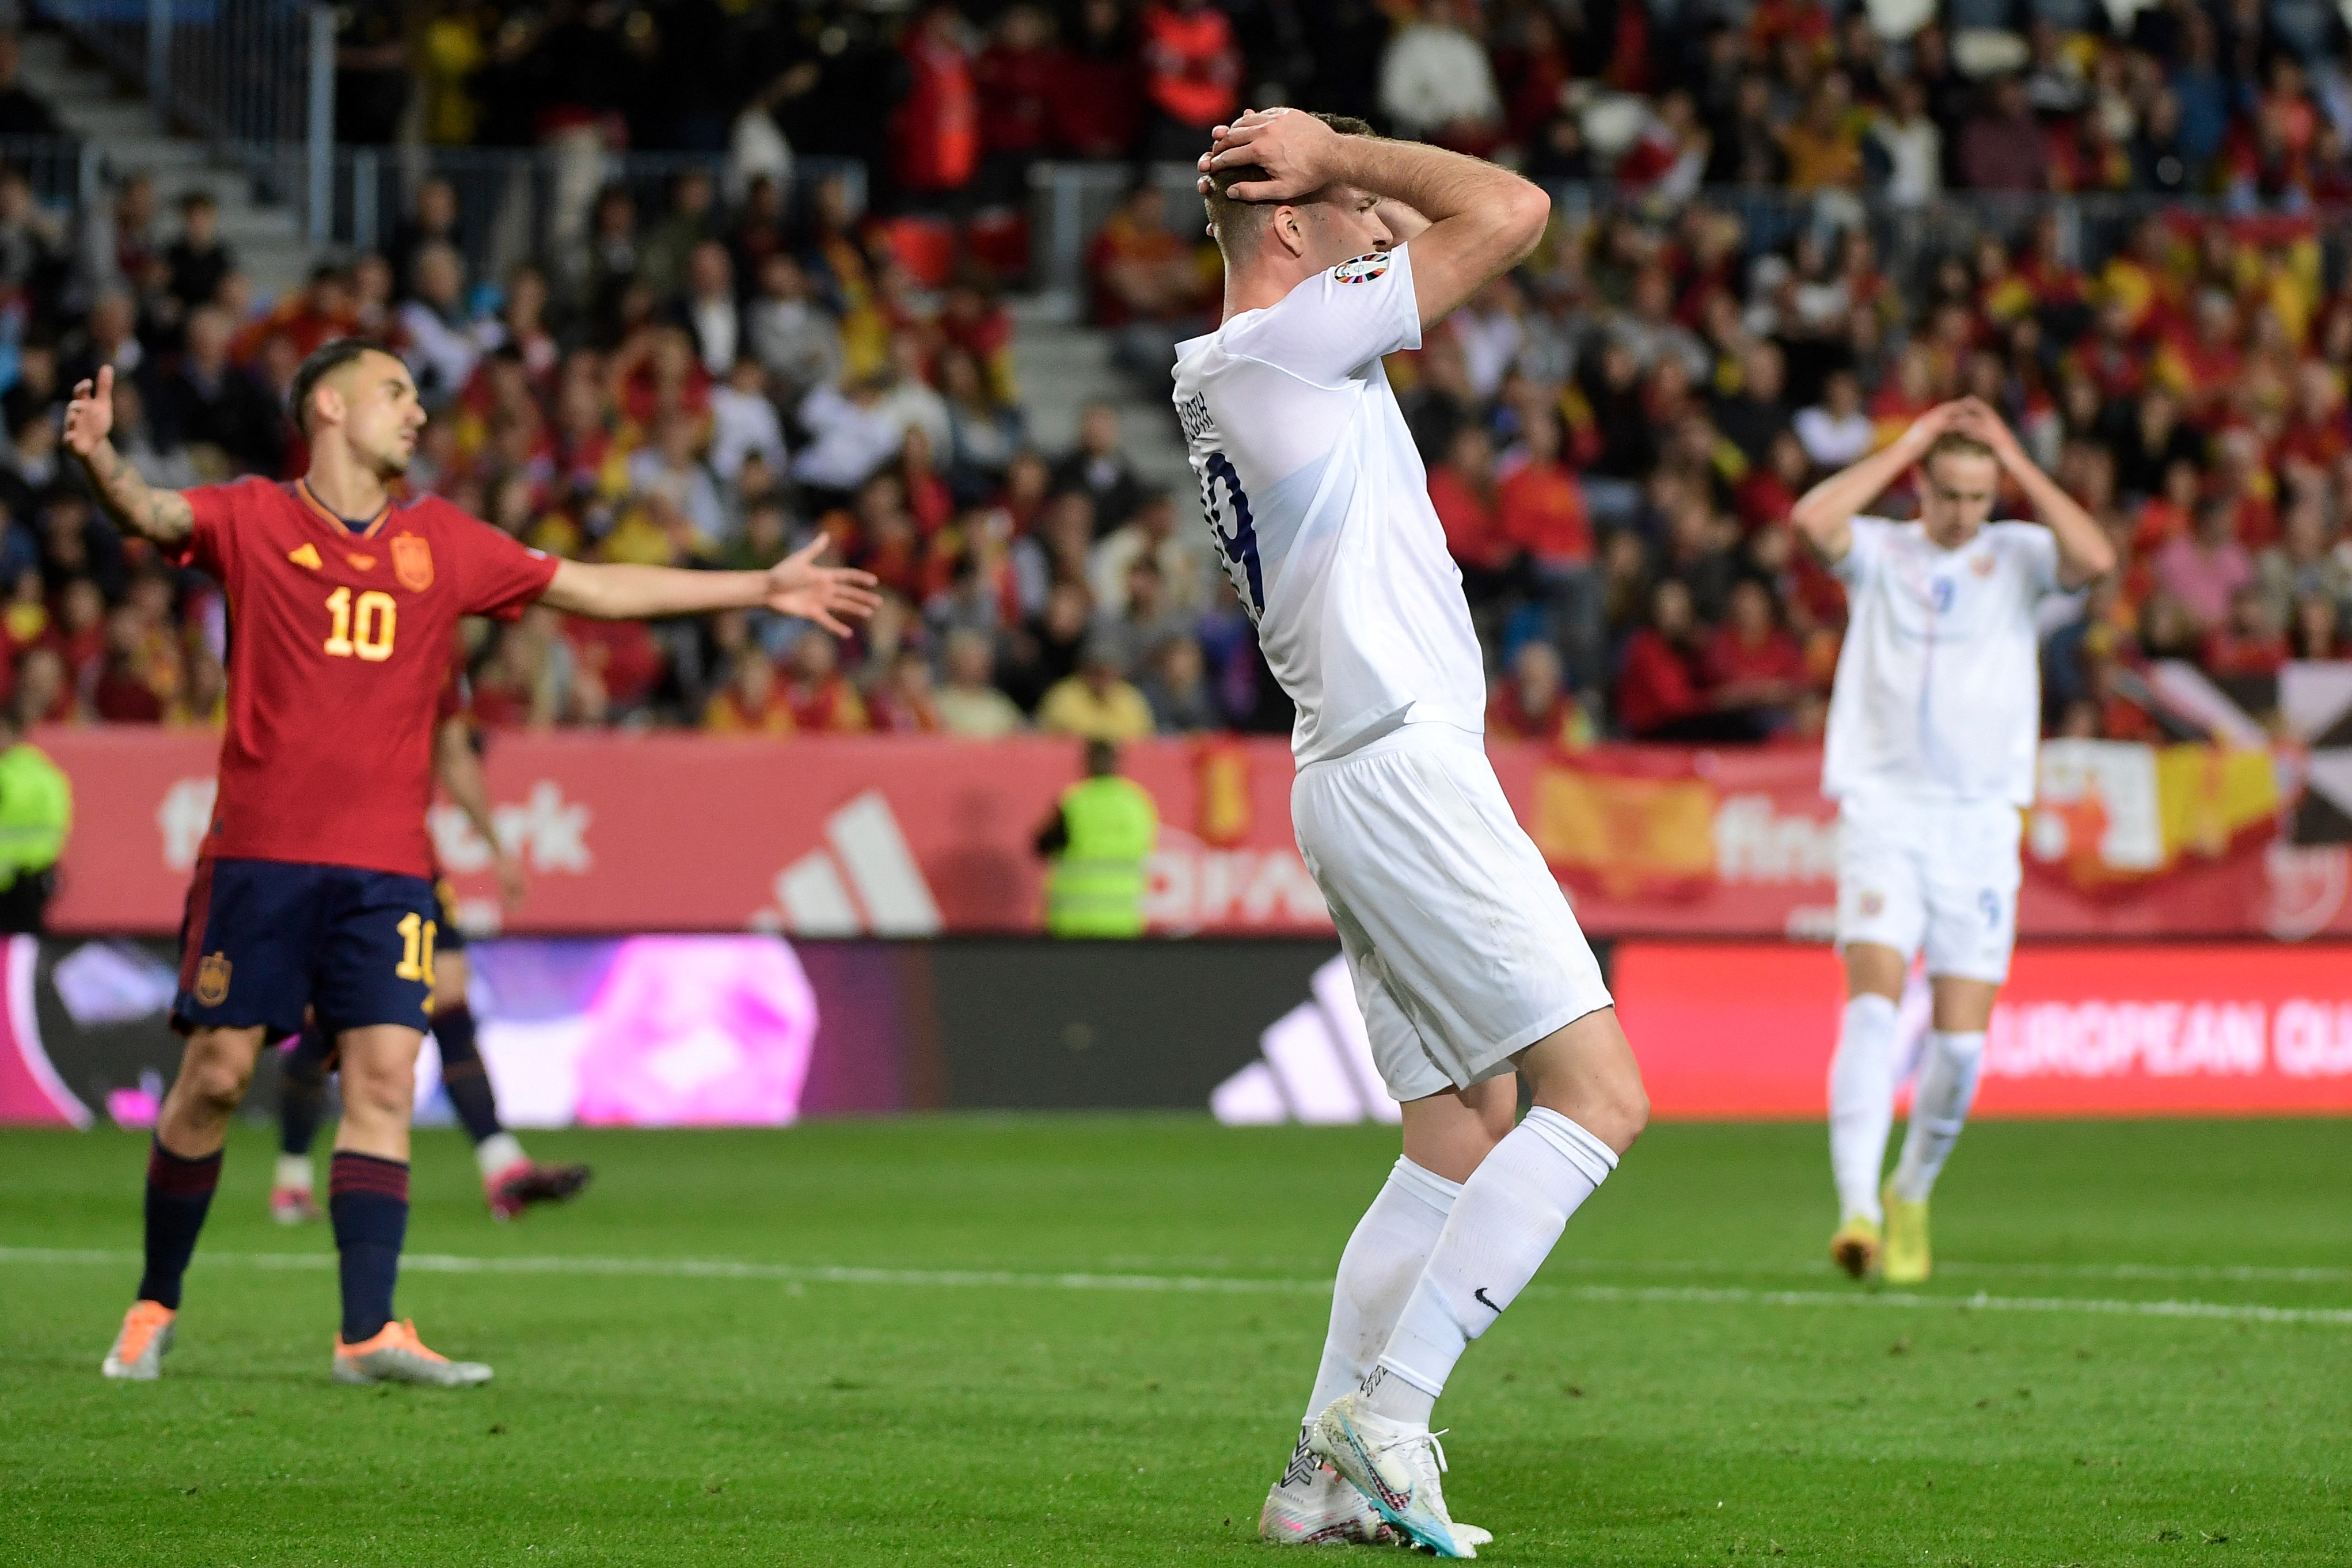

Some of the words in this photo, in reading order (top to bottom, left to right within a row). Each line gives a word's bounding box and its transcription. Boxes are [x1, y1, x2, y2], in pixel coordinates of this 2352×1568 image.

[1200, 452, 1266, 629] 9
[323, 585, 397, 662] 10
[1984, 998, 2268, 1076] UROPEAN
